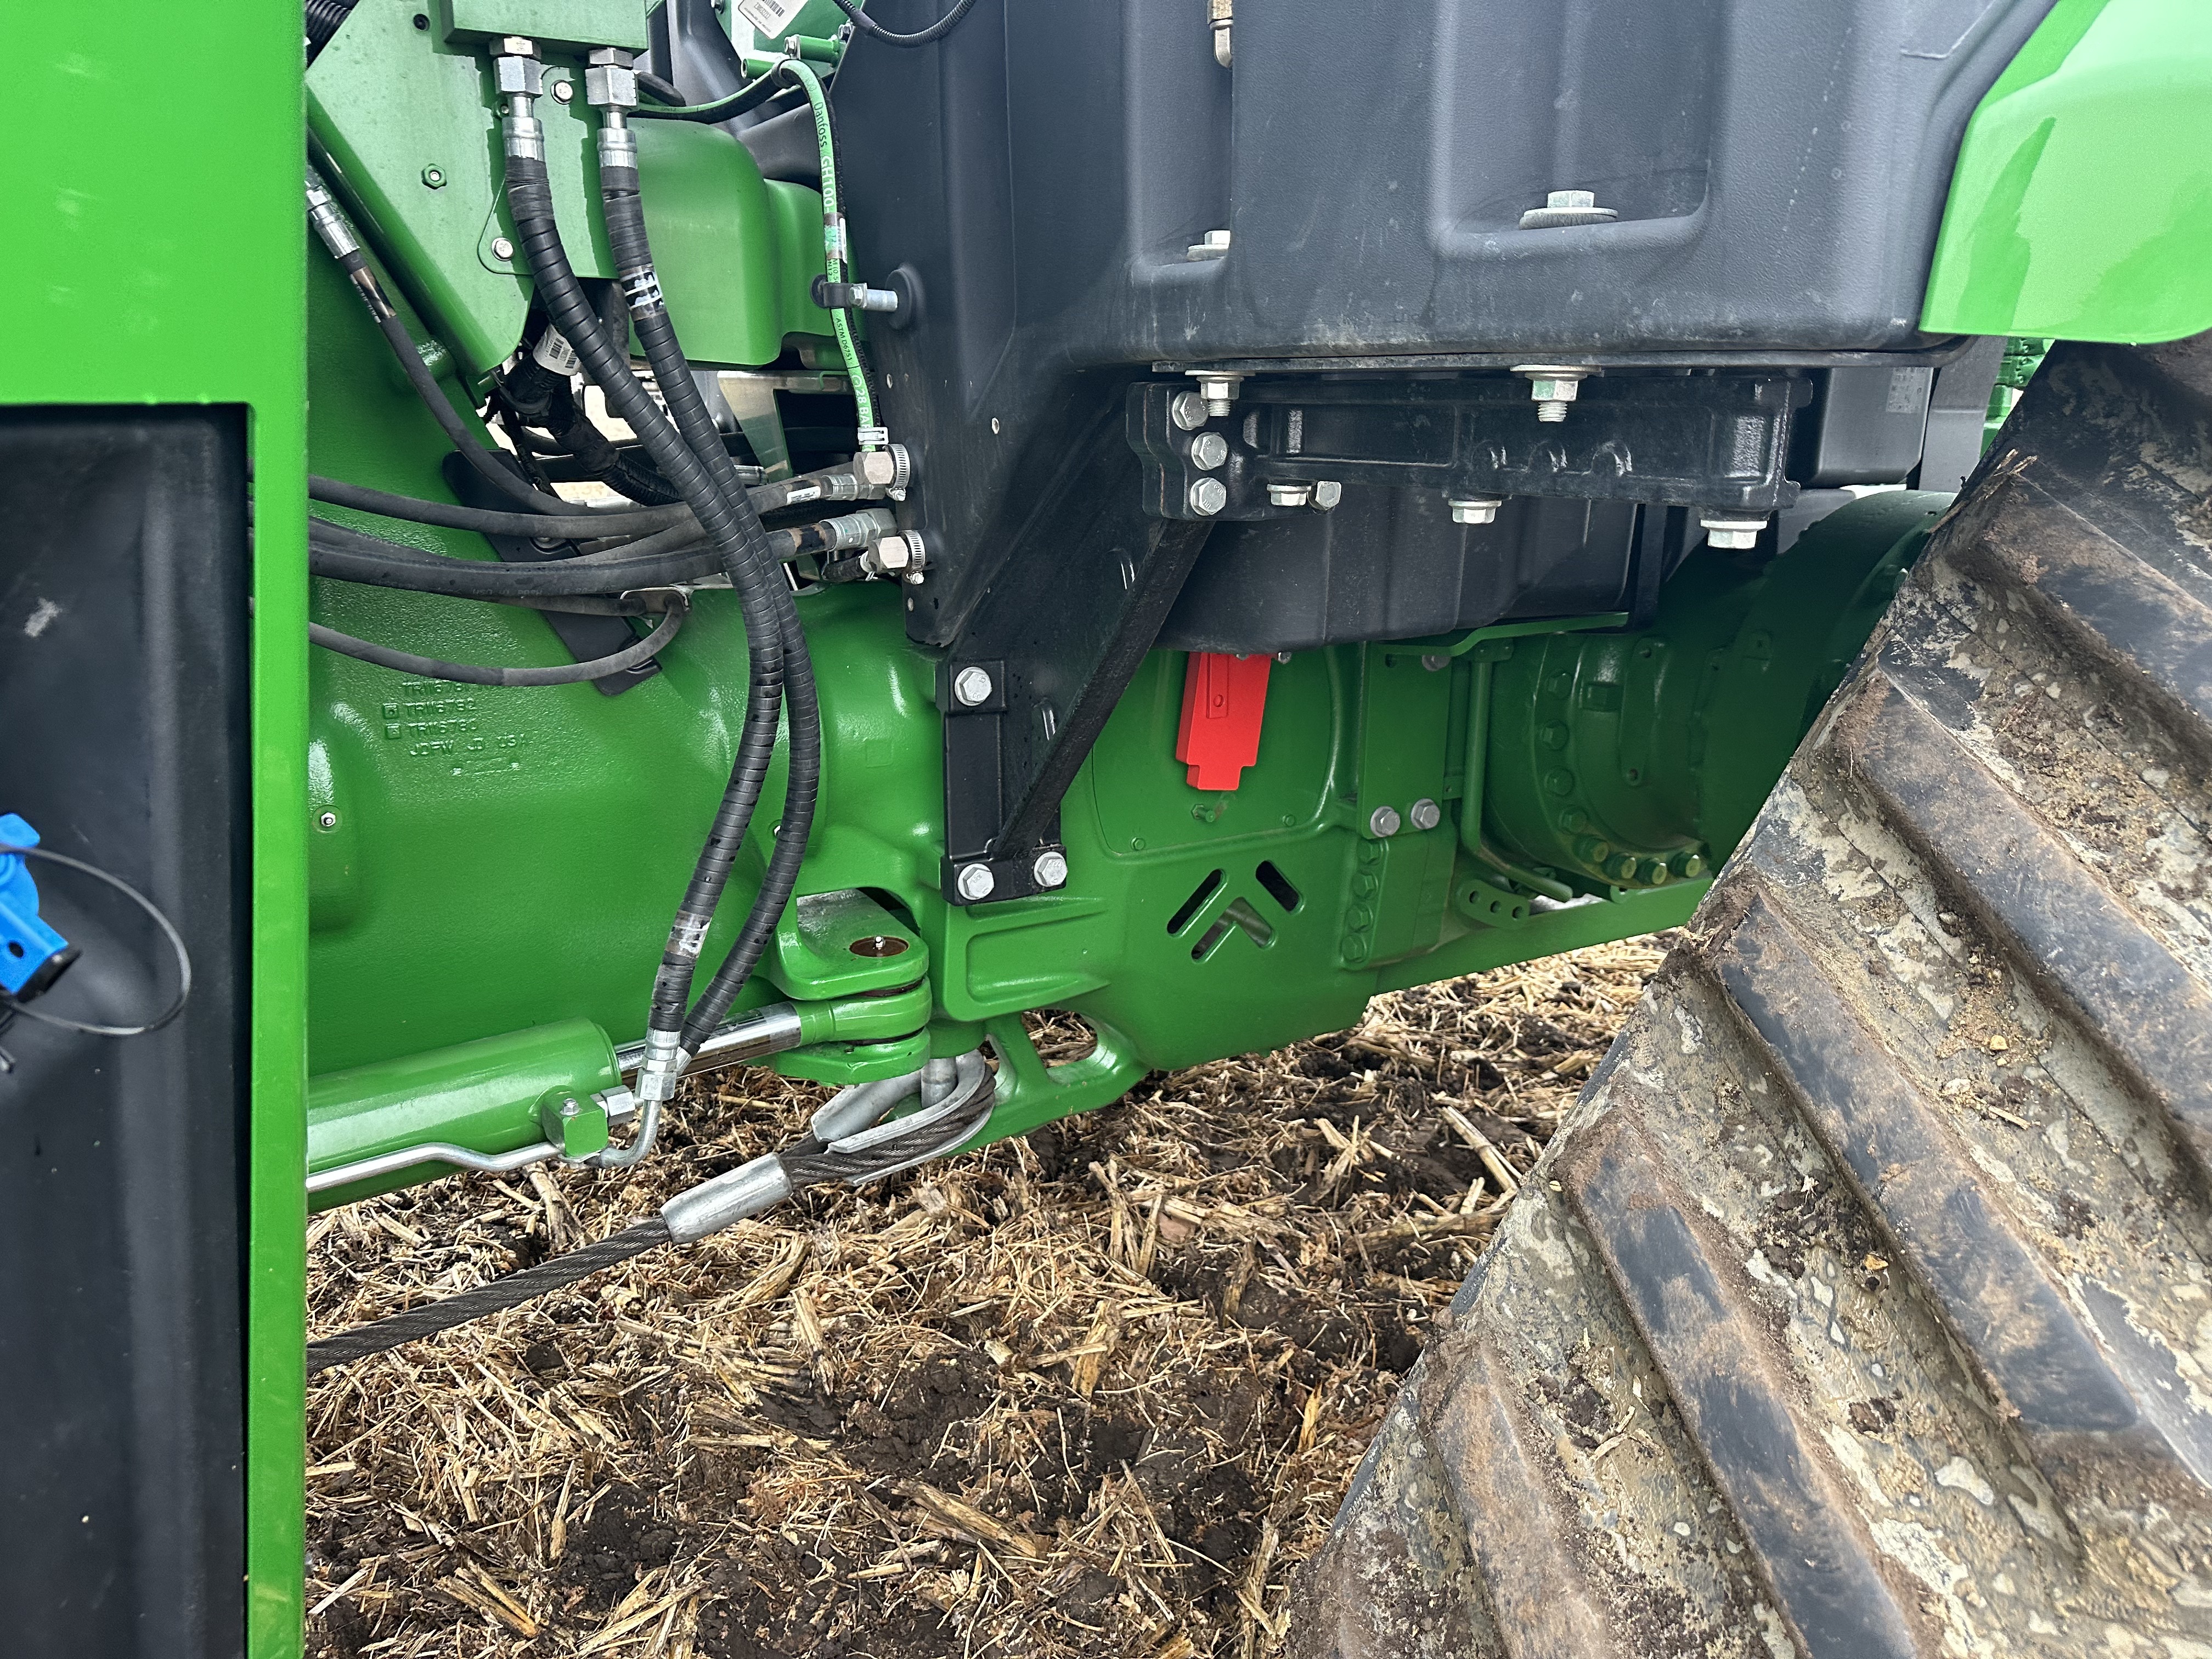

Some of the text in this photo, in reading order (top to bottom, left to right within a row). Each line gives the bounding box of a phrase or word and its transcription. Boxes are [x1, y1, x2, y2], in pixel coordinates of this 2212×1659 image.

[814, 101, 828, 148] Danfoss
[836, 318, 853, 360] ASTM D6751
[855, 388, 867, 404] 28
